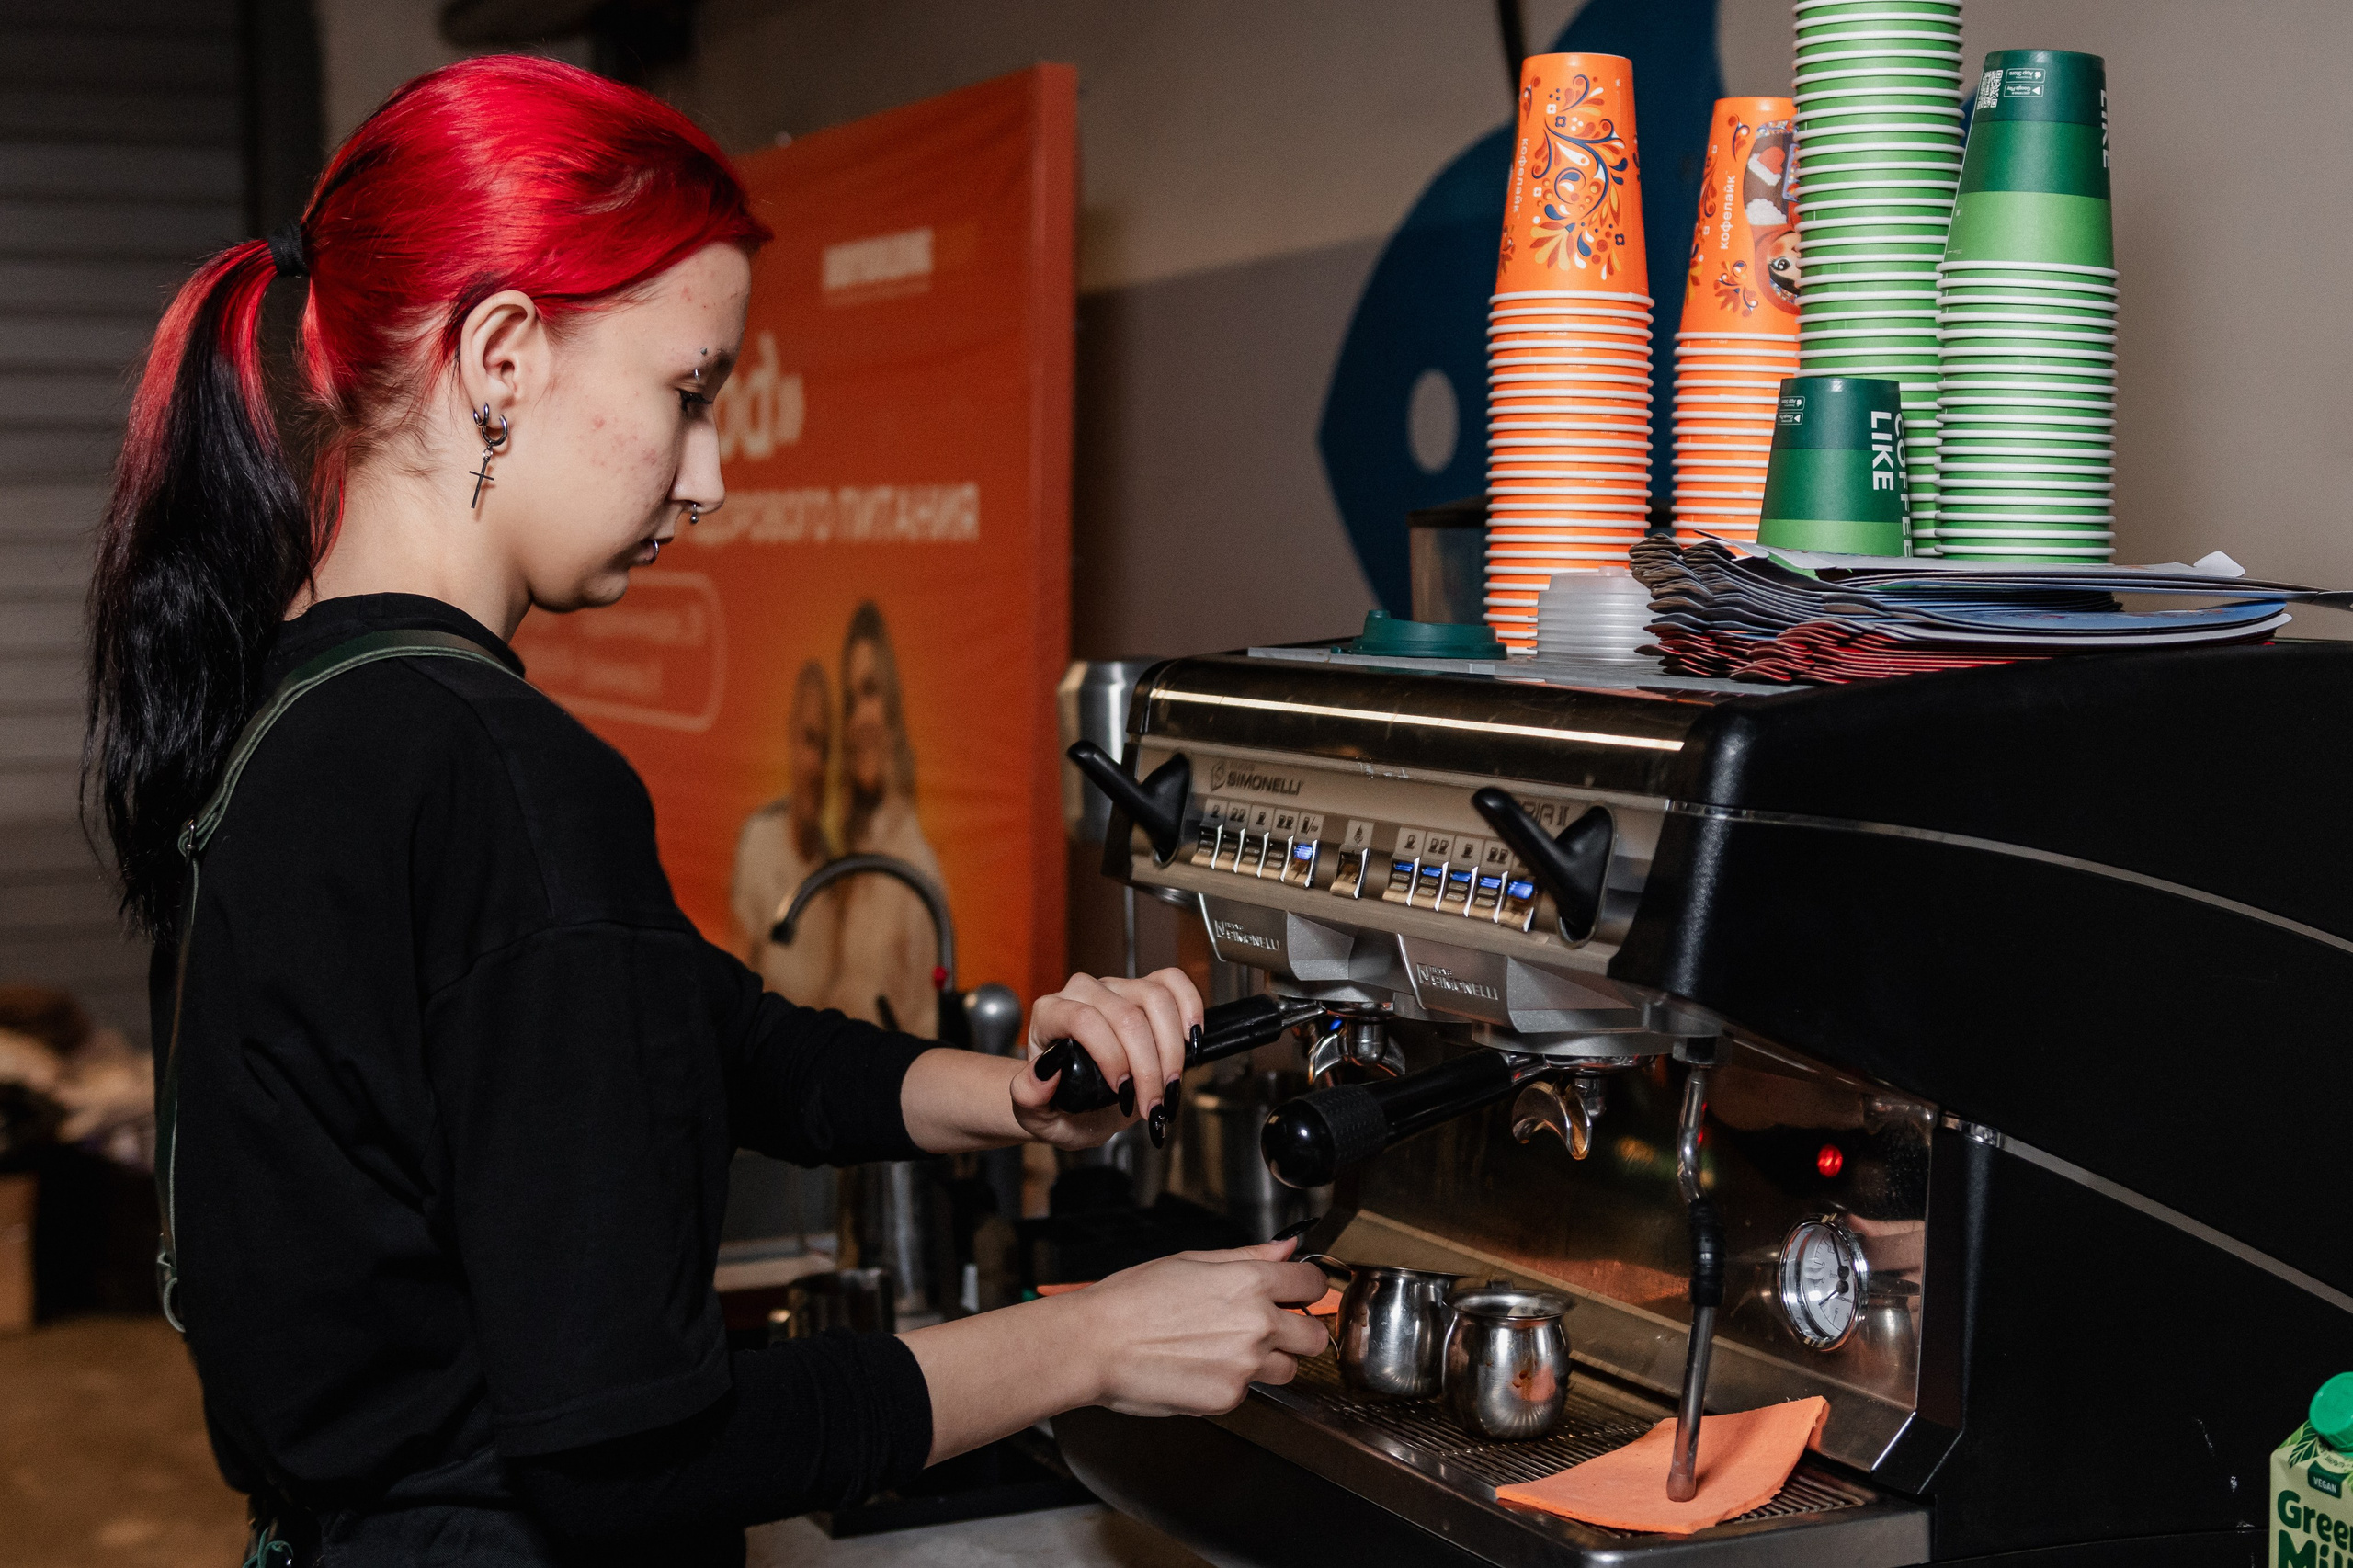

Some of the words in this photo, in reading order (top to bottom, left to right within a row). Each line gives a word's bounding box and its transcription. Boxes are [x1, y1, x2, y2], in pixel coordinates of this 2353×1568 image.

[1513, 138, 1529, 214] кофелайк
[1720, 174, 1736, 250] кофелайк
[1871, 411, 1894, 490] LIKE
[1894, 413, 1914, 557] COFFEE
[1227, 770, 1302, 797] SIMONELLI
[1521, 801, 1555, 825] PIA
[1226, 930, 1280, 951] SIMONELLI
[1431, 975, 1498, 1001] SIMONELLI
[2313, 1476, 2336, 1494] VEGAN
[2278, 1490, 2353, 1554] Gree
